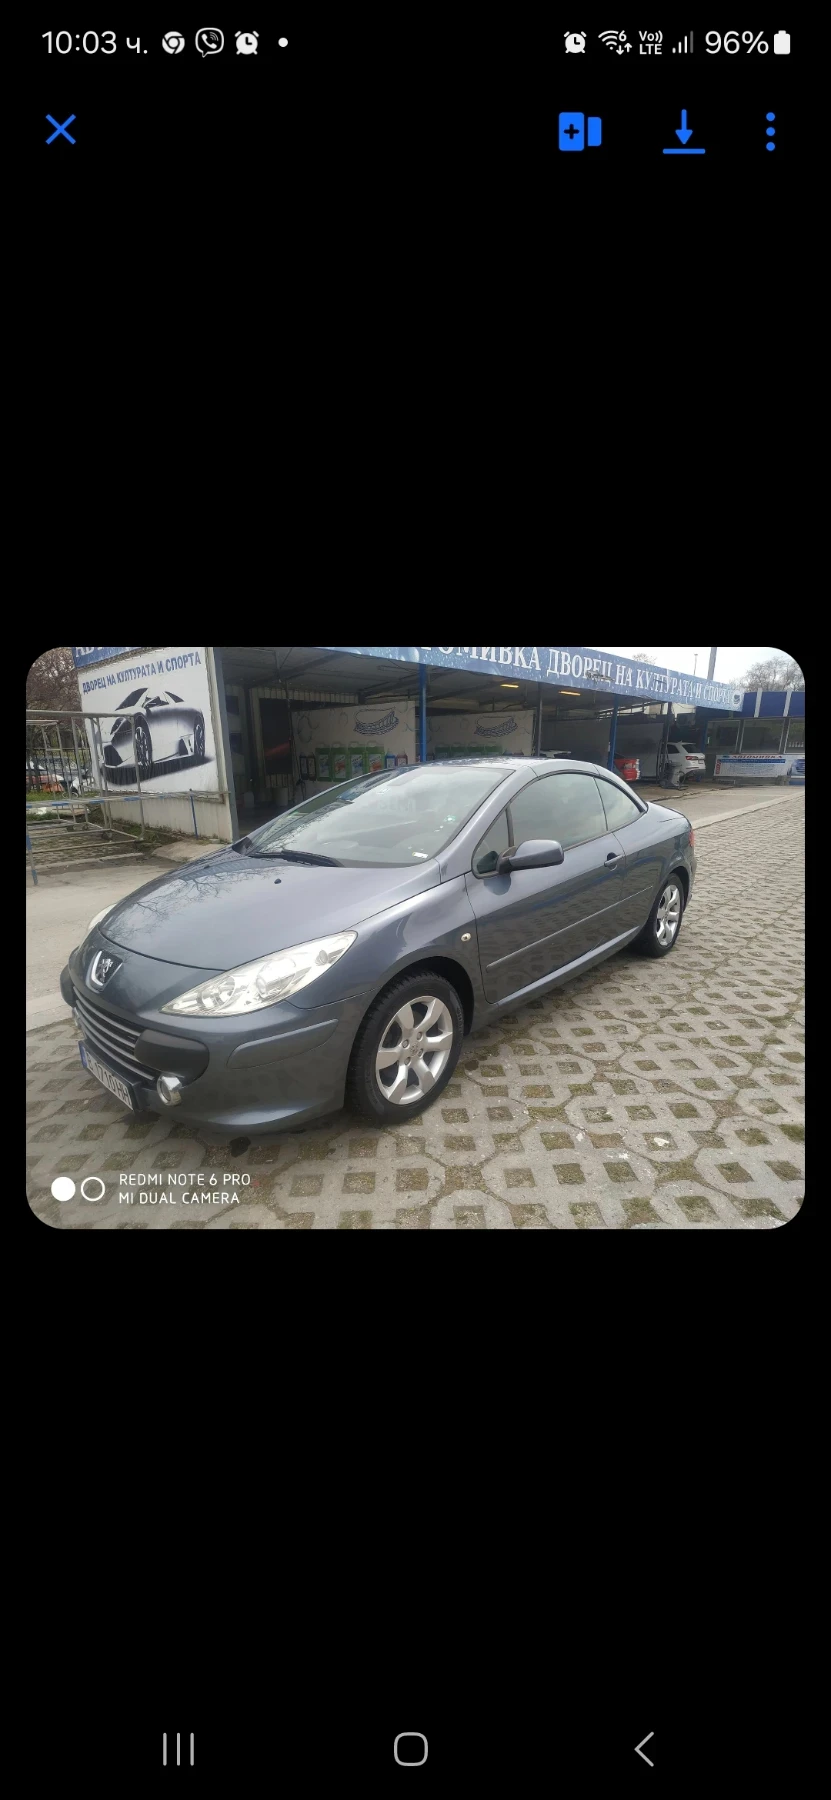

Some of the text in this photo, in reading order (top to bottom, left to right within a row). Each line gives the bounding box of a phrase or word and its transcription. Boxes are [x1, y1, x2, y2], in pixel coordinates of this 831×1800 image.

[42, 30, 148, 54] 10:03 ч.
[639, 43, 663, 55] LTE
[705, 30, 769, 54] 96%
[82, 651, 202, 695] ДВОРЕЦ НА КУЛТУРАТА И СПОРТА
[546, 649, 613, 683] ДВОРЕЦ
[615, 664, 632, 687] НА
